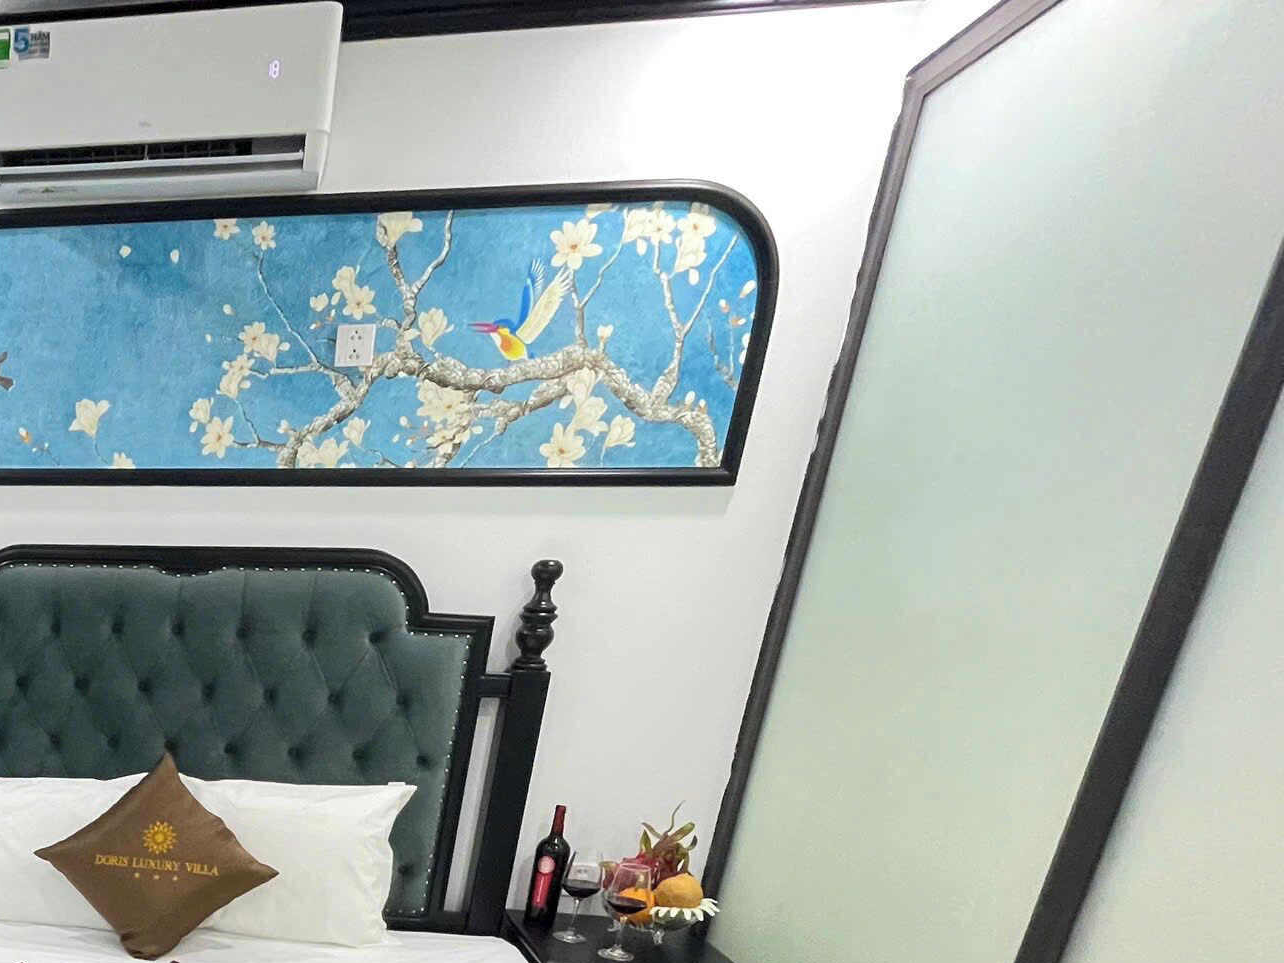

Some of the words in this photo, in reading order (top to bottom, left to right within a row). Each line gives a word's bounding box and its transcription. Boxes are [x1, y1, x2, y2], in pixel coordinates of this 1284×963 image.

[95, 854, 129, 867] DORIS
[132, 857, 180, 871] LUXURY
[185, 862, 219, 876] VILLA
